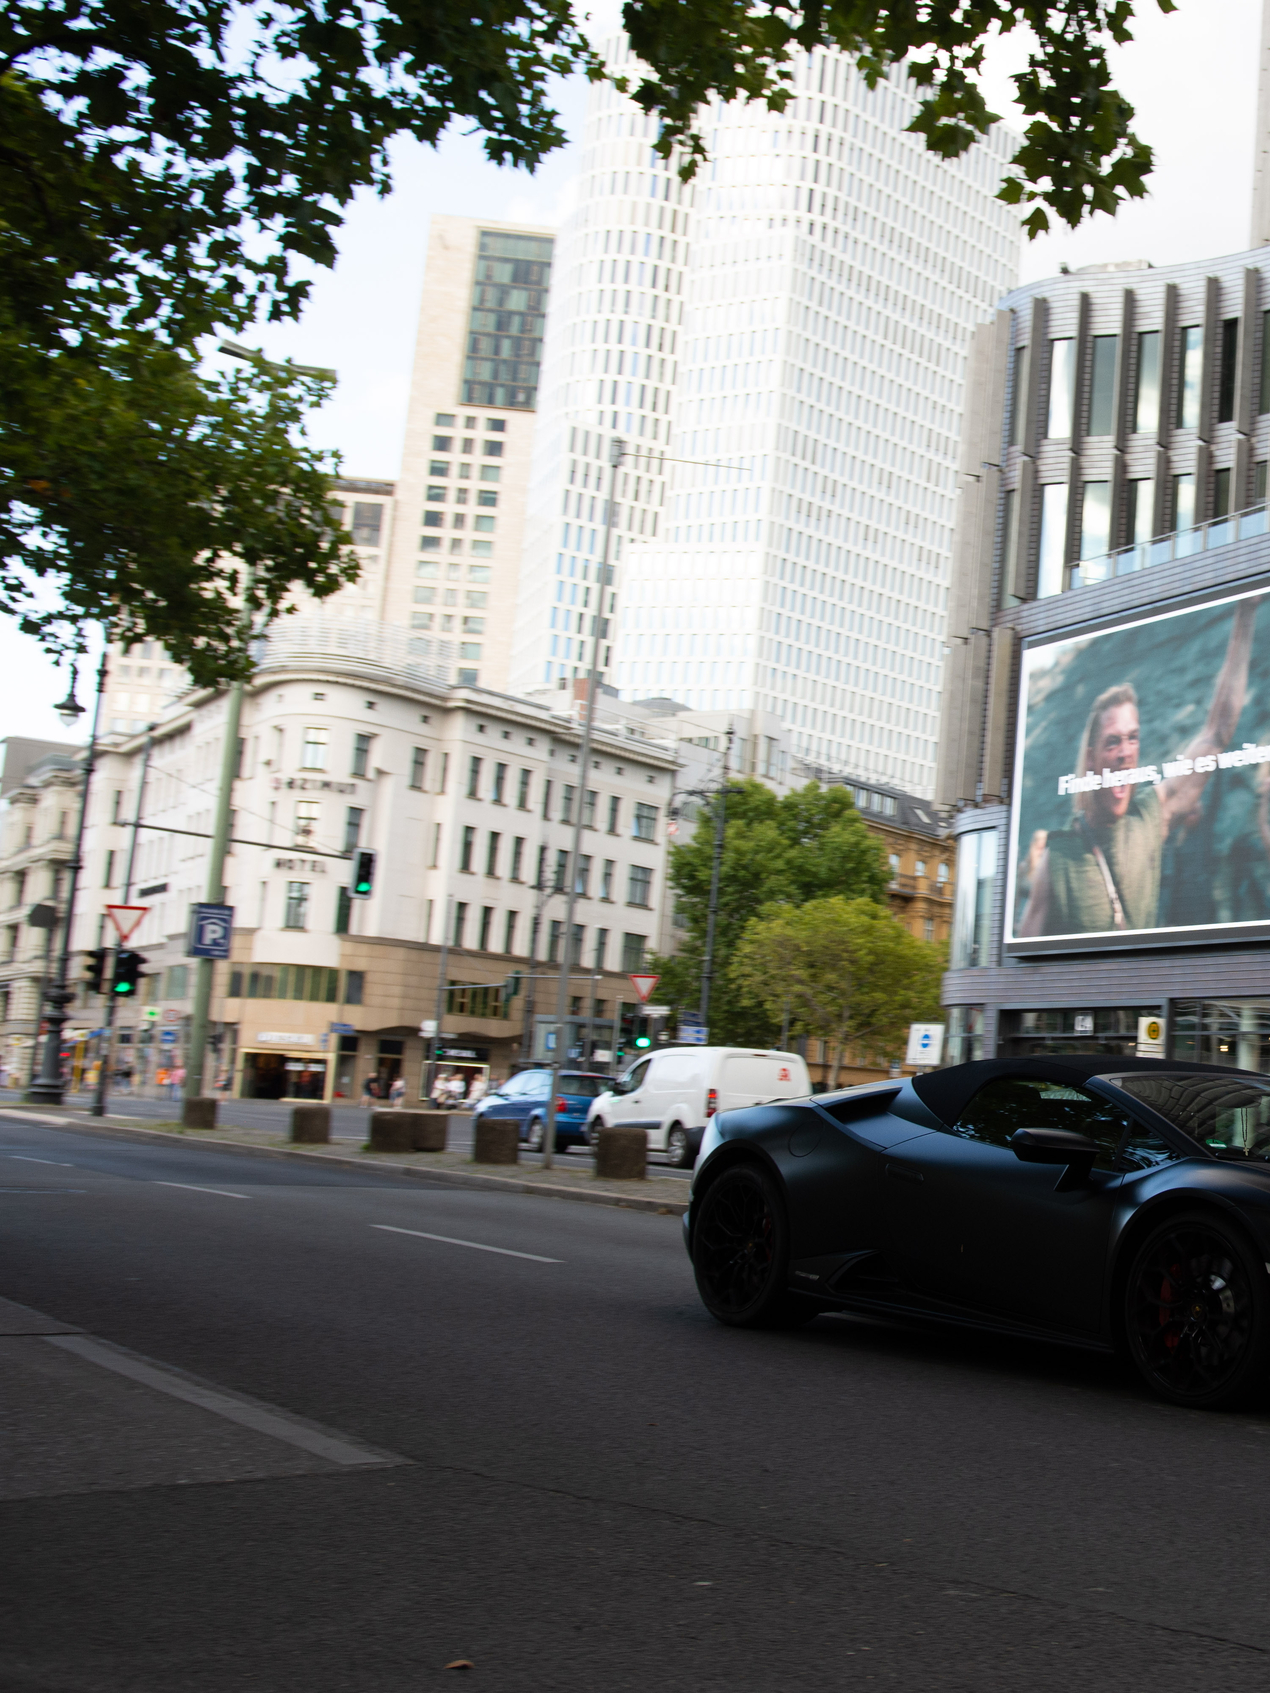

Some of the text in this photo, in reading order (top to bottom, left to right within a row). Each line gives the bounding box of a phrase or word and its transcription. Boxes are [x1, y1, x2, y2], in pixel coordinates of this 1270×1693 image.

[1057, 770, 1102, 796] Finde
[1102, 764, 1162, 785] heraus,
[1162, 754, 1193, 779] wie
[1193, 754, 1217, 774] es
[201, 923, 225, 945] P
